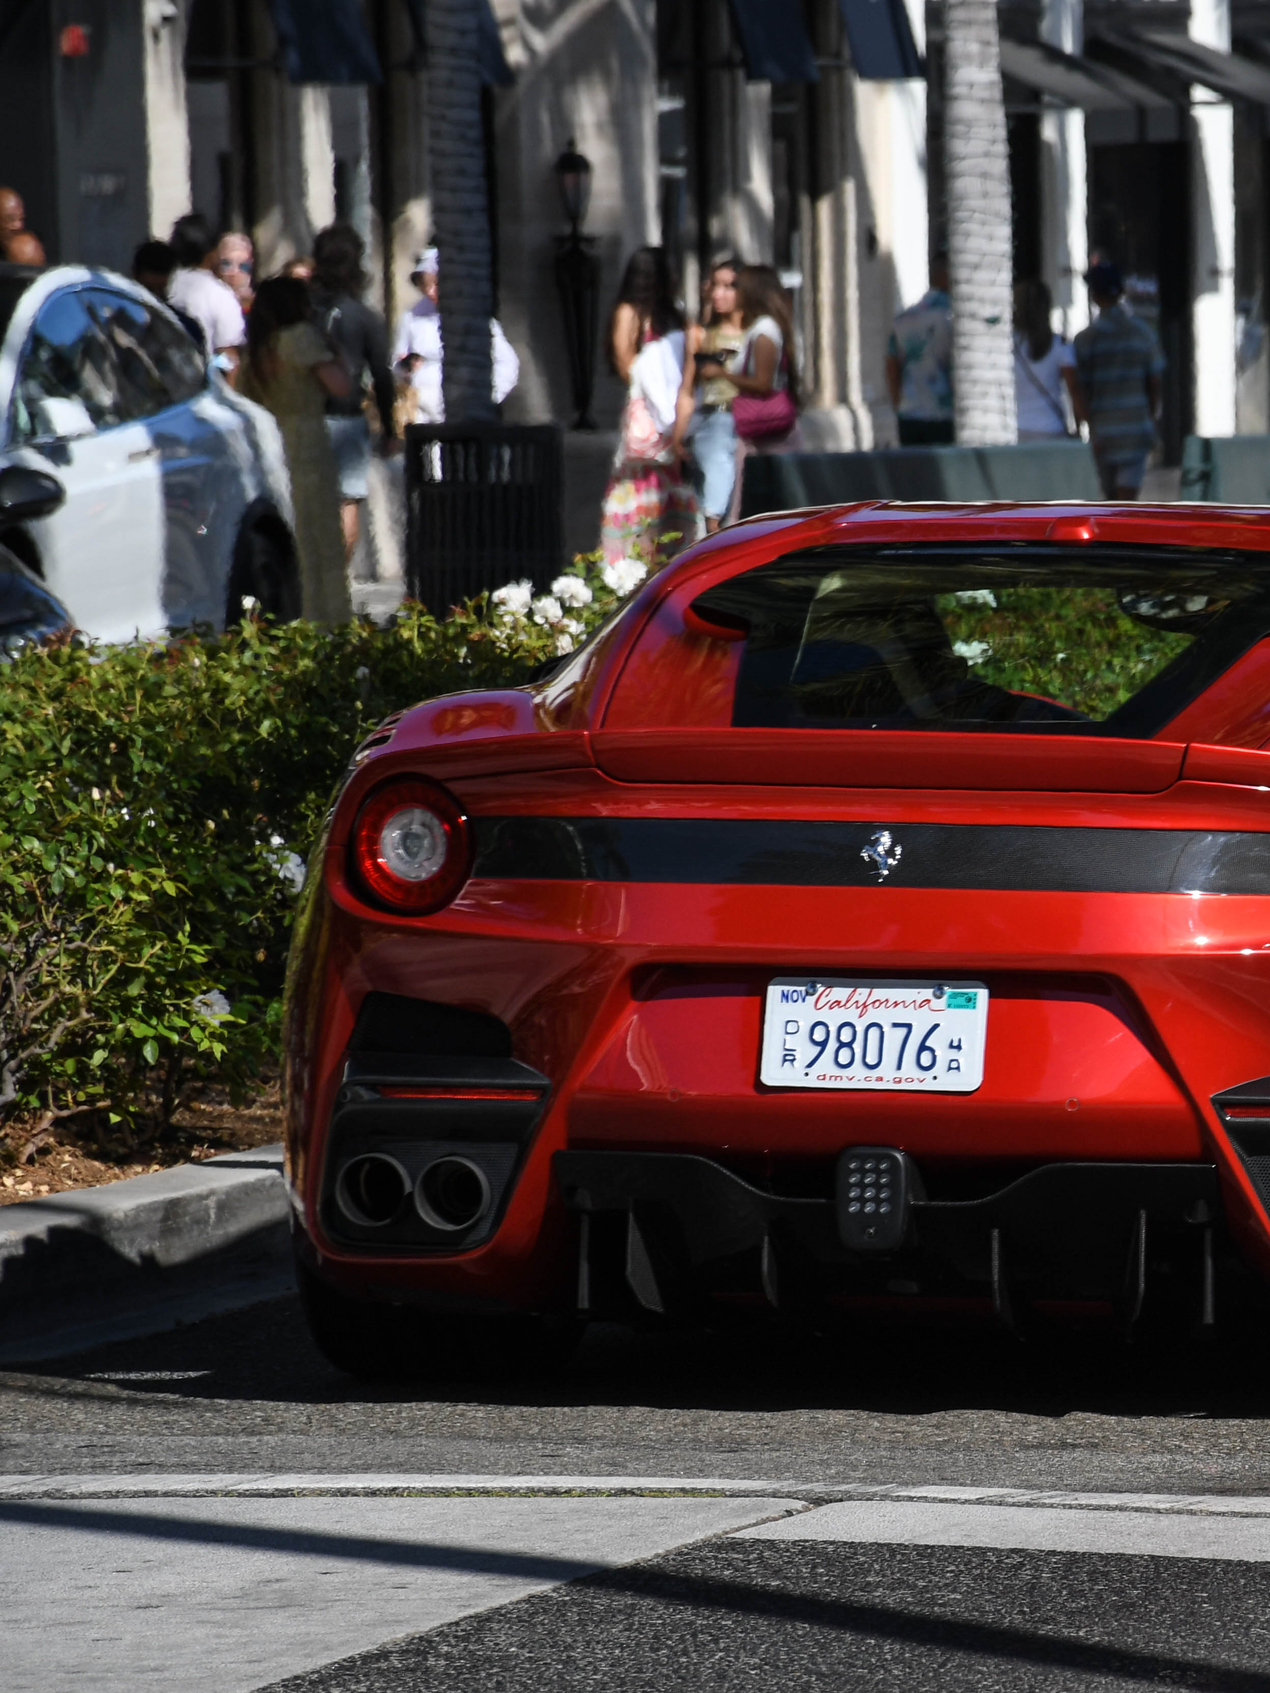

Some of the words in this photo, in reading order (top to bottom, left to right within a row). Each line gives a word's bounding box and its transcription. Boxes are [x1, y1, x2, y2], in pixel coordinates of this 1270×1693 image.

[780, 989, 807, 1003] NOV
[813, 986, 946, 1018] California
[805, 1020, 941, 1072] 98076
[816, 1073, 928, 1084] dmv.ca.gov
